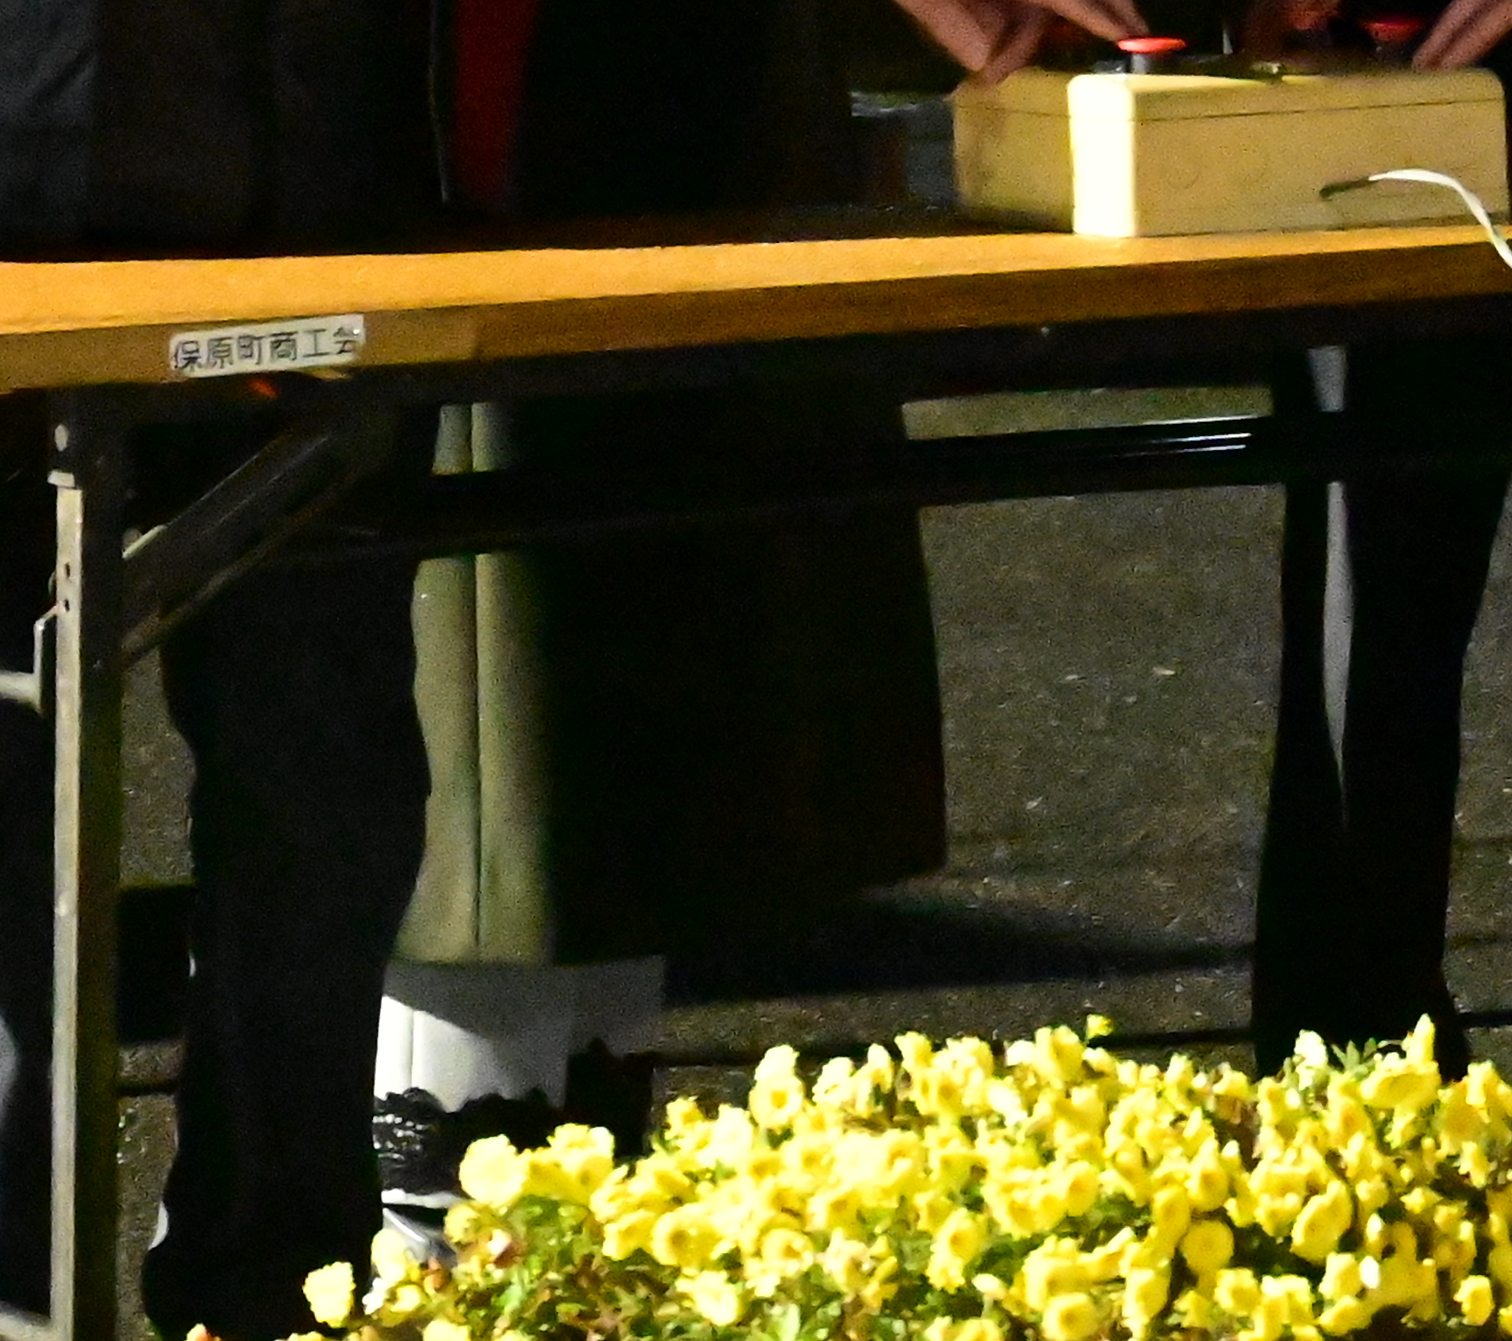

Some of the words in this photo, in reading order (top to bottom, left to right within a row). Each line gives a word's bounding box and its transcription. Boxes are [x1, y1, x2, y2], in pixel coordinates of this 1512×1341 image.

[173, 327, 358, 372] 保原町商工会
